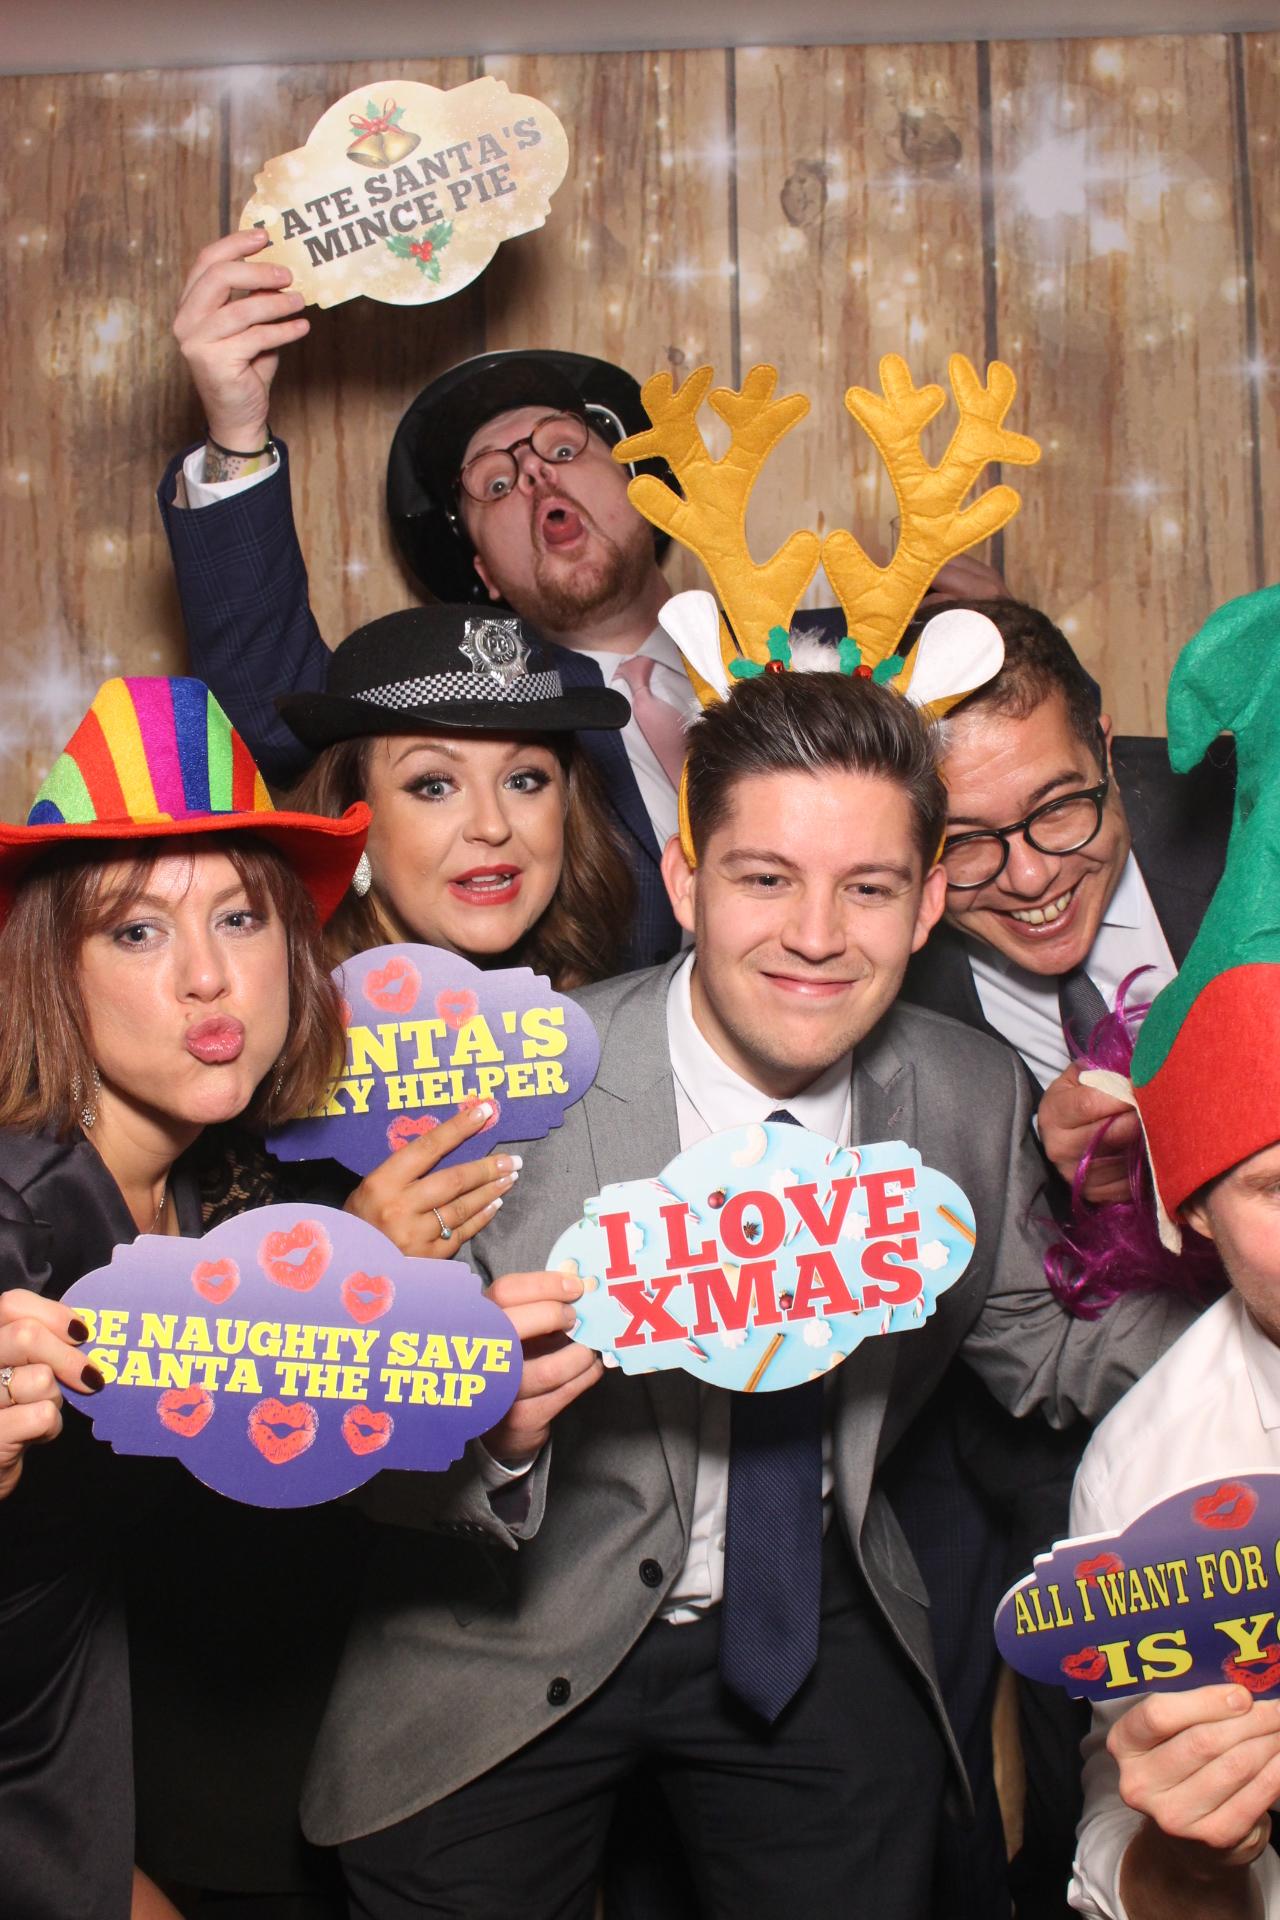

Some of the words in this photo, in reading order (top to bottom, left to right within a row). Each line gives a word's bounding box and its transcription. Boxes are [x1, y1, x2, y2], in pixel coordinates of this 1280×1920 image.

[280, 187, 360, 241] ATE
[364, 117, 542, 207] SANTA'S
[302, 192, 444, 268] MINCE
[446, 163, 517, 213] PIE
[330, 1007, 570, 1077] NTA'S
[386, 1061, 569, 1110] HELPER
[600, 1211, 638, 1279] I
[660, 1167, 921, 1270] LOVE
[608, 1237, 924, 1350] XMAS
[87, 1347, 262, 1394] SANTA
[275, 1361, 369, 1401] THE
[380, 1368, 486, 1407] TRIP
[138, 1312, 380, 1363] NAUGHTY
[387, 1331, 512, 1373] SAVE
[1014, 1584, 1074, 1635] ALL
[1076, 1578, 1096, 1622] I
[1097, 1559, 1189, 1617] WANT
[1196, 1545, 1268, 1600] FOR
[1097, 1629, 1193, 1688] IS
[1213, 1611, 1280, 1664] Y
